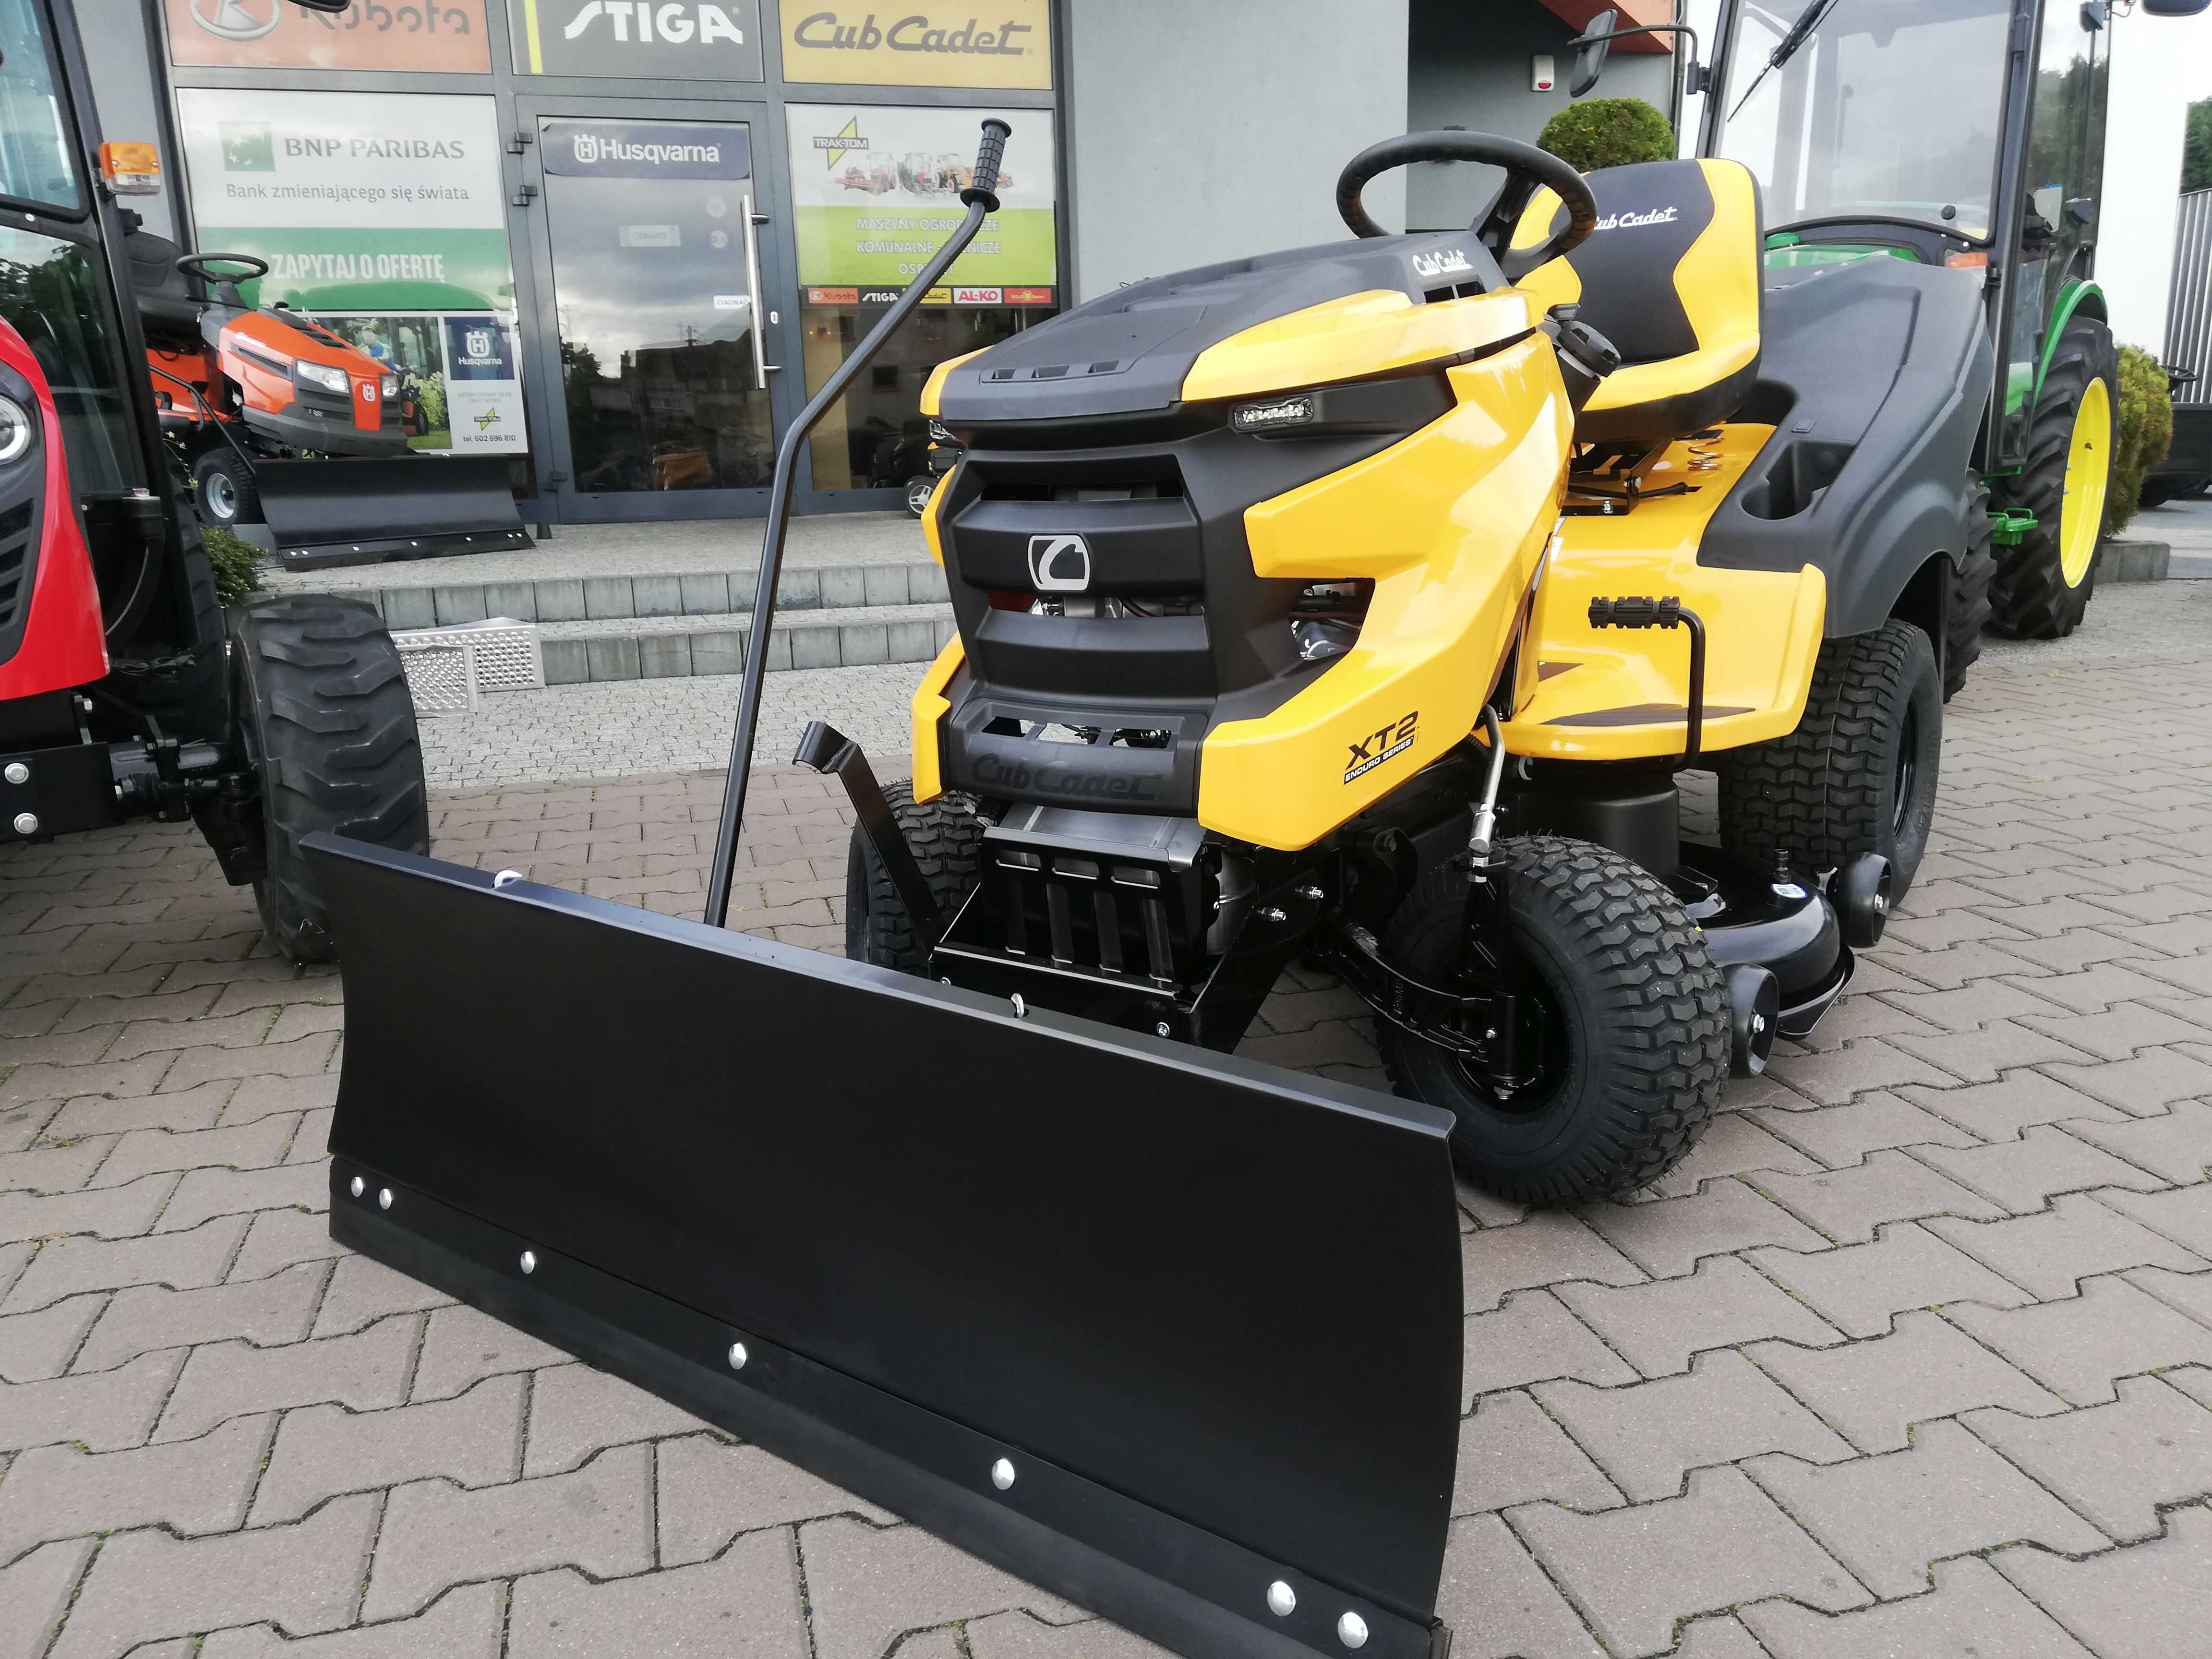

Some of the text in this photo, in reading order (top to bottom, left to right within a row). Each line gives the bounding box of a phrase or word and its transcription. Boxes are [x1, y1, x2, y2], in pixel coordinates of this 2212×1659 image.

[300, 0, 470, 34] Kubota
[565, 1, 743, 44] STIGA
[794, 12, 1033, 55] Cub Cadet
[284, 138, 465, 159] BNP PARIBAS
[600, 138, 720, 164] Husqvarna
[814, 138, 867, 148] TRAK-TOM
[227, 183, 469, 203] Bank zmieniającego się świata
[857, 218, 999, 231] MASZYNY OGROZE
[1619, 206, 1678, 228] Cadet
[856, 241, 933, 253] KOMUNALNE
[271, 253, 445, 283] ZAPYTAJ O OFERTĘ
[1412, 249, 1472, 276] Cub Cadet
[824, 289, 857, 300] Kubota
[862, 292, 899, 301] STIGA
[958, 290, 998, 301] AL-KO
[458, 357, 502, 366] Husqvarna
[1345, 710, 1419, 770] XT2
[1346, 737, 1412, 782] ENDURO SERIES
[972, 752, 1163, 801] Cub Cadet
